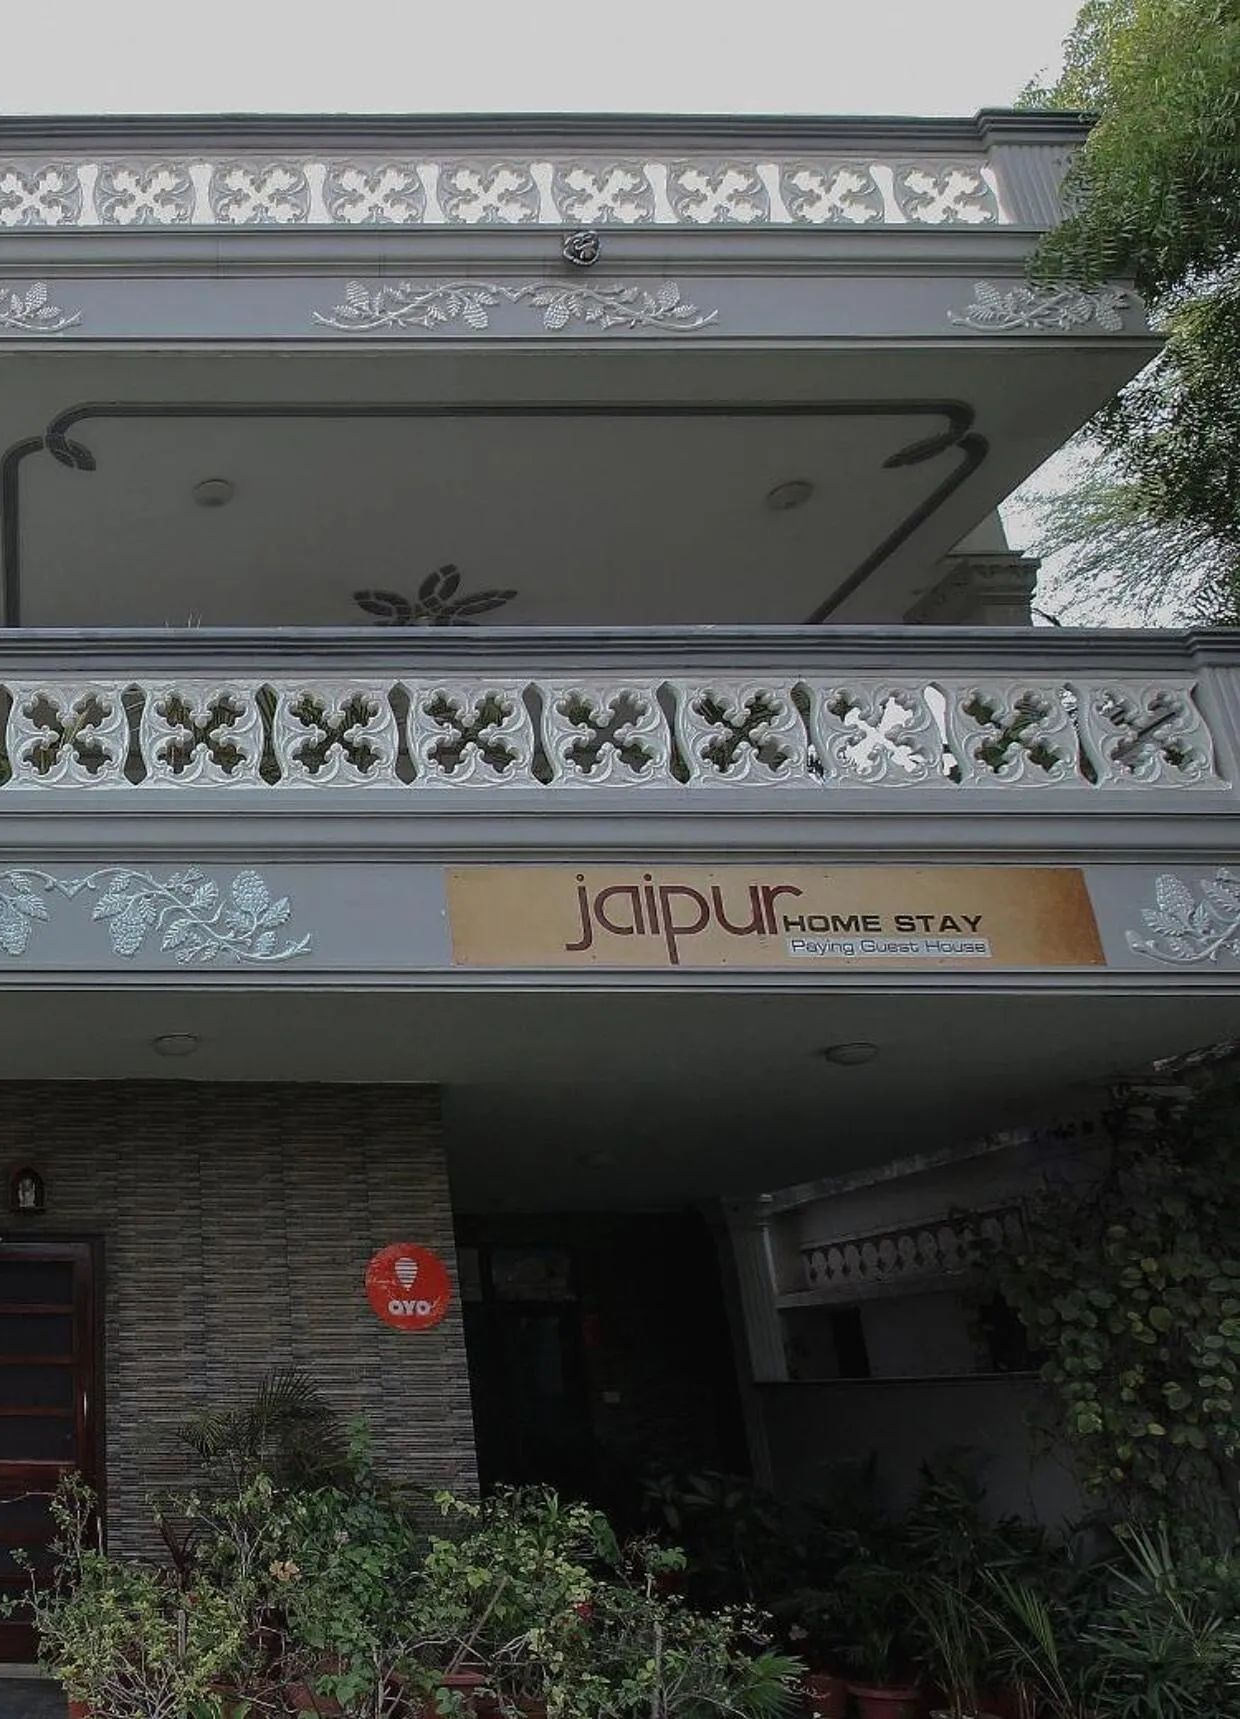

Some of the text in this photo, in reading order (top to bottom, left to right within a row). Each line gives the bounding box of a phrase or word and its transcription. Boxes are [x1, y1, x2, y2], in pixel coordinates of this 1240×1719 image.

[566, 873, 803, 965] jaipur
[783, 915, 982, 932] HOME STAY
[791, 939, 986, 955] Paying Guest House
[388, 1300, 431, 1315] OYO
